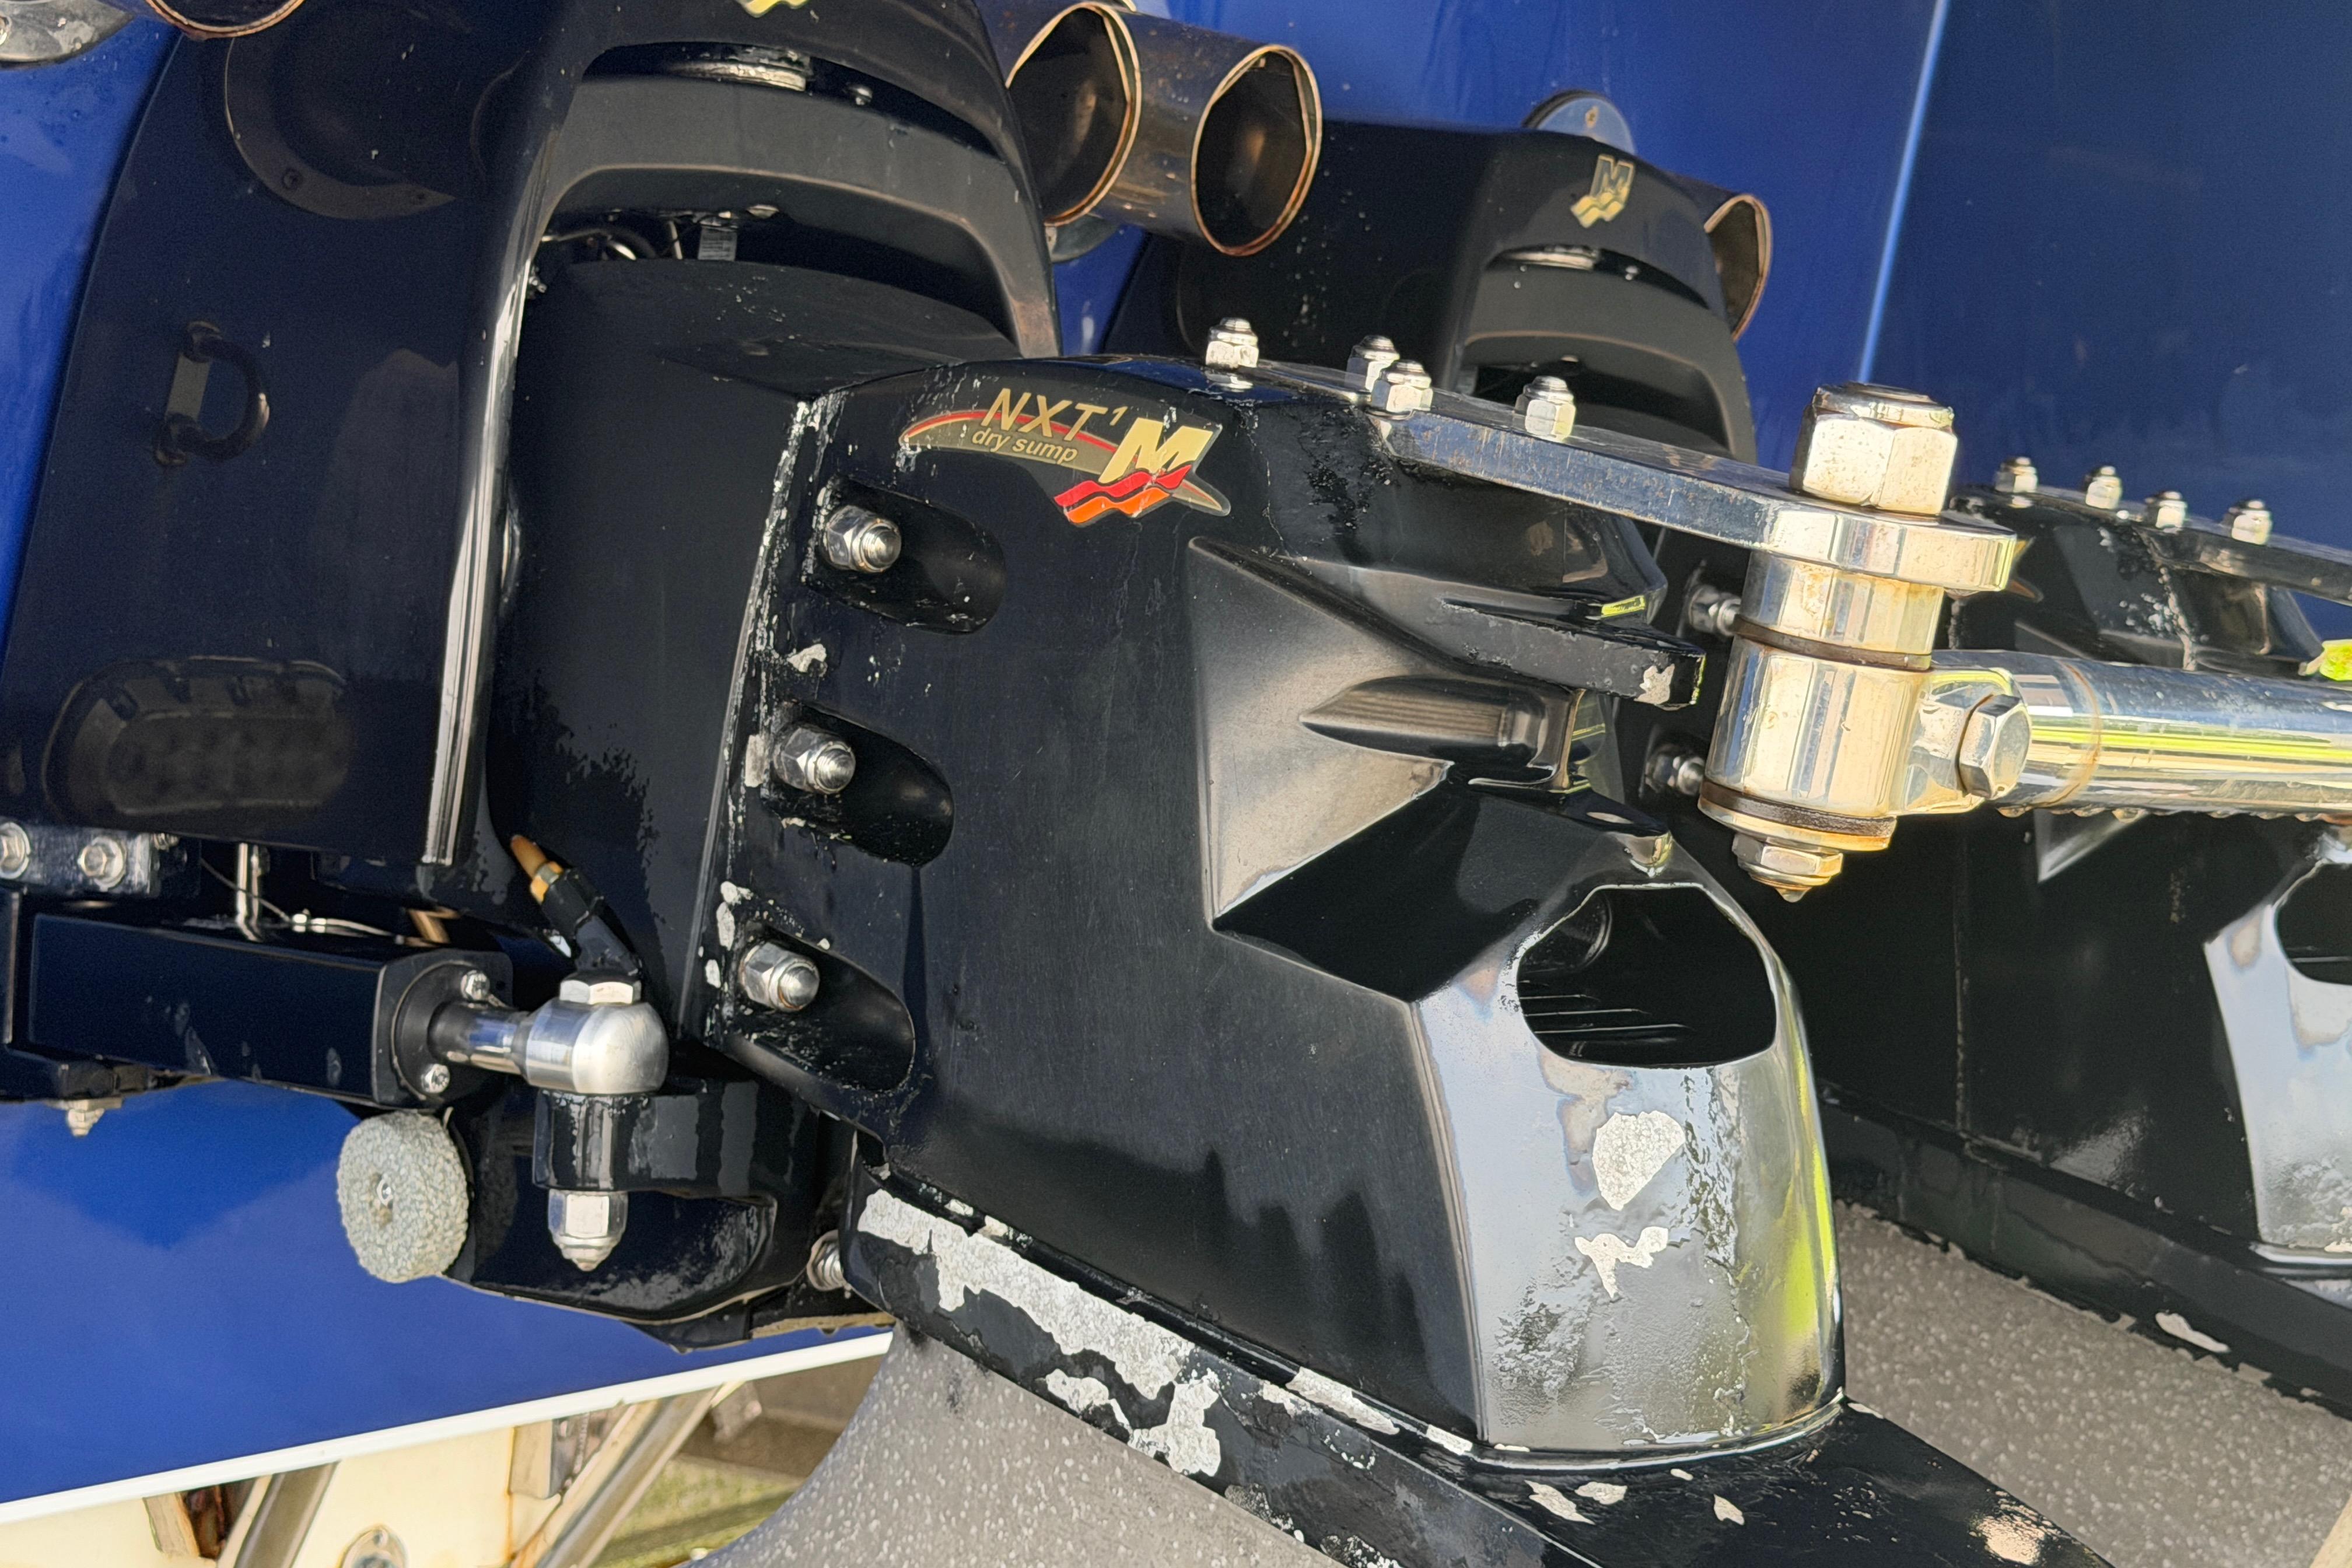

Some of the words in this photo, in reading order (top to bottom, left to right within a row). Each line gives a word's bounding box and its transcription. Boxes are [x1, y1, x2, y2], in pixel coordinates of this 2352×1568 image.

[972, 428, 1010, 452] dry
[1012, 438, 1078, 465] sump
[1098, 417, 1213, 484] M
